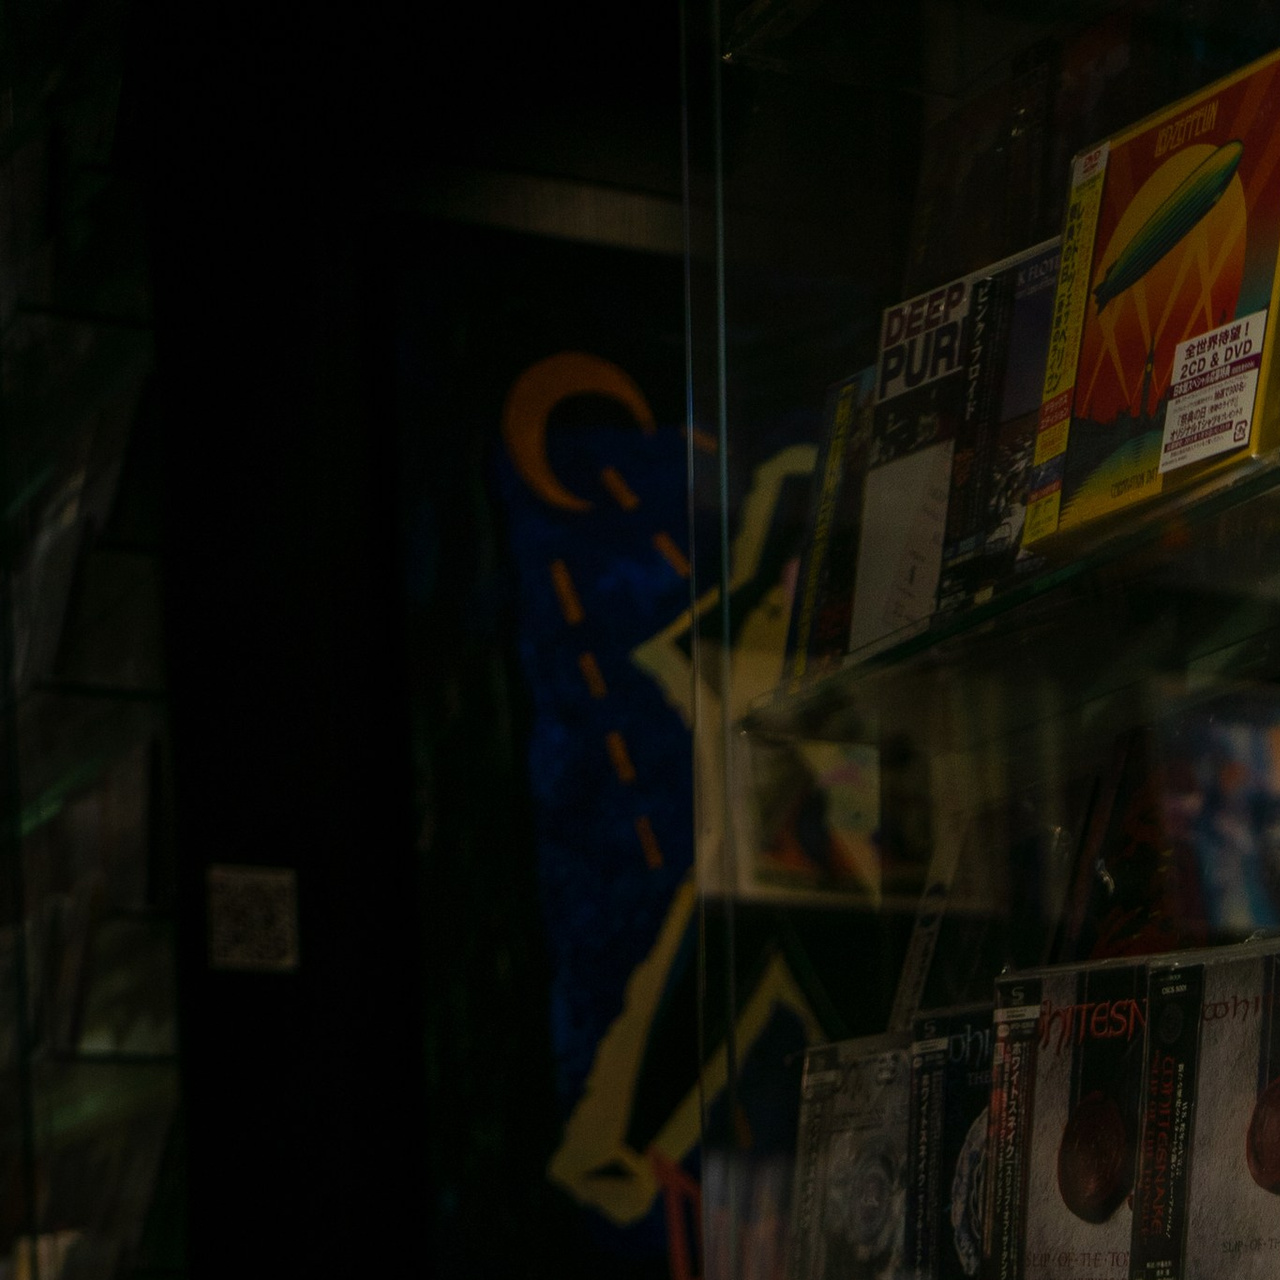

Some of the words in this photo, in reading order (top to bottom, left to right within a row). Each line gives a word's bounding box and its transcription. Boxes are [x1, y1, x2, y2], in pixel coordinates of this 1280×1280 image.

[884, 281, 964, 348] DEEP
[1180, 357, 1206, 380] 2CD
[1210, 352, 1220, 368] &
[1224, 339, 1253, 363] DVD
[1005, 1043, 1023, 1162] ホワイトスネイク
